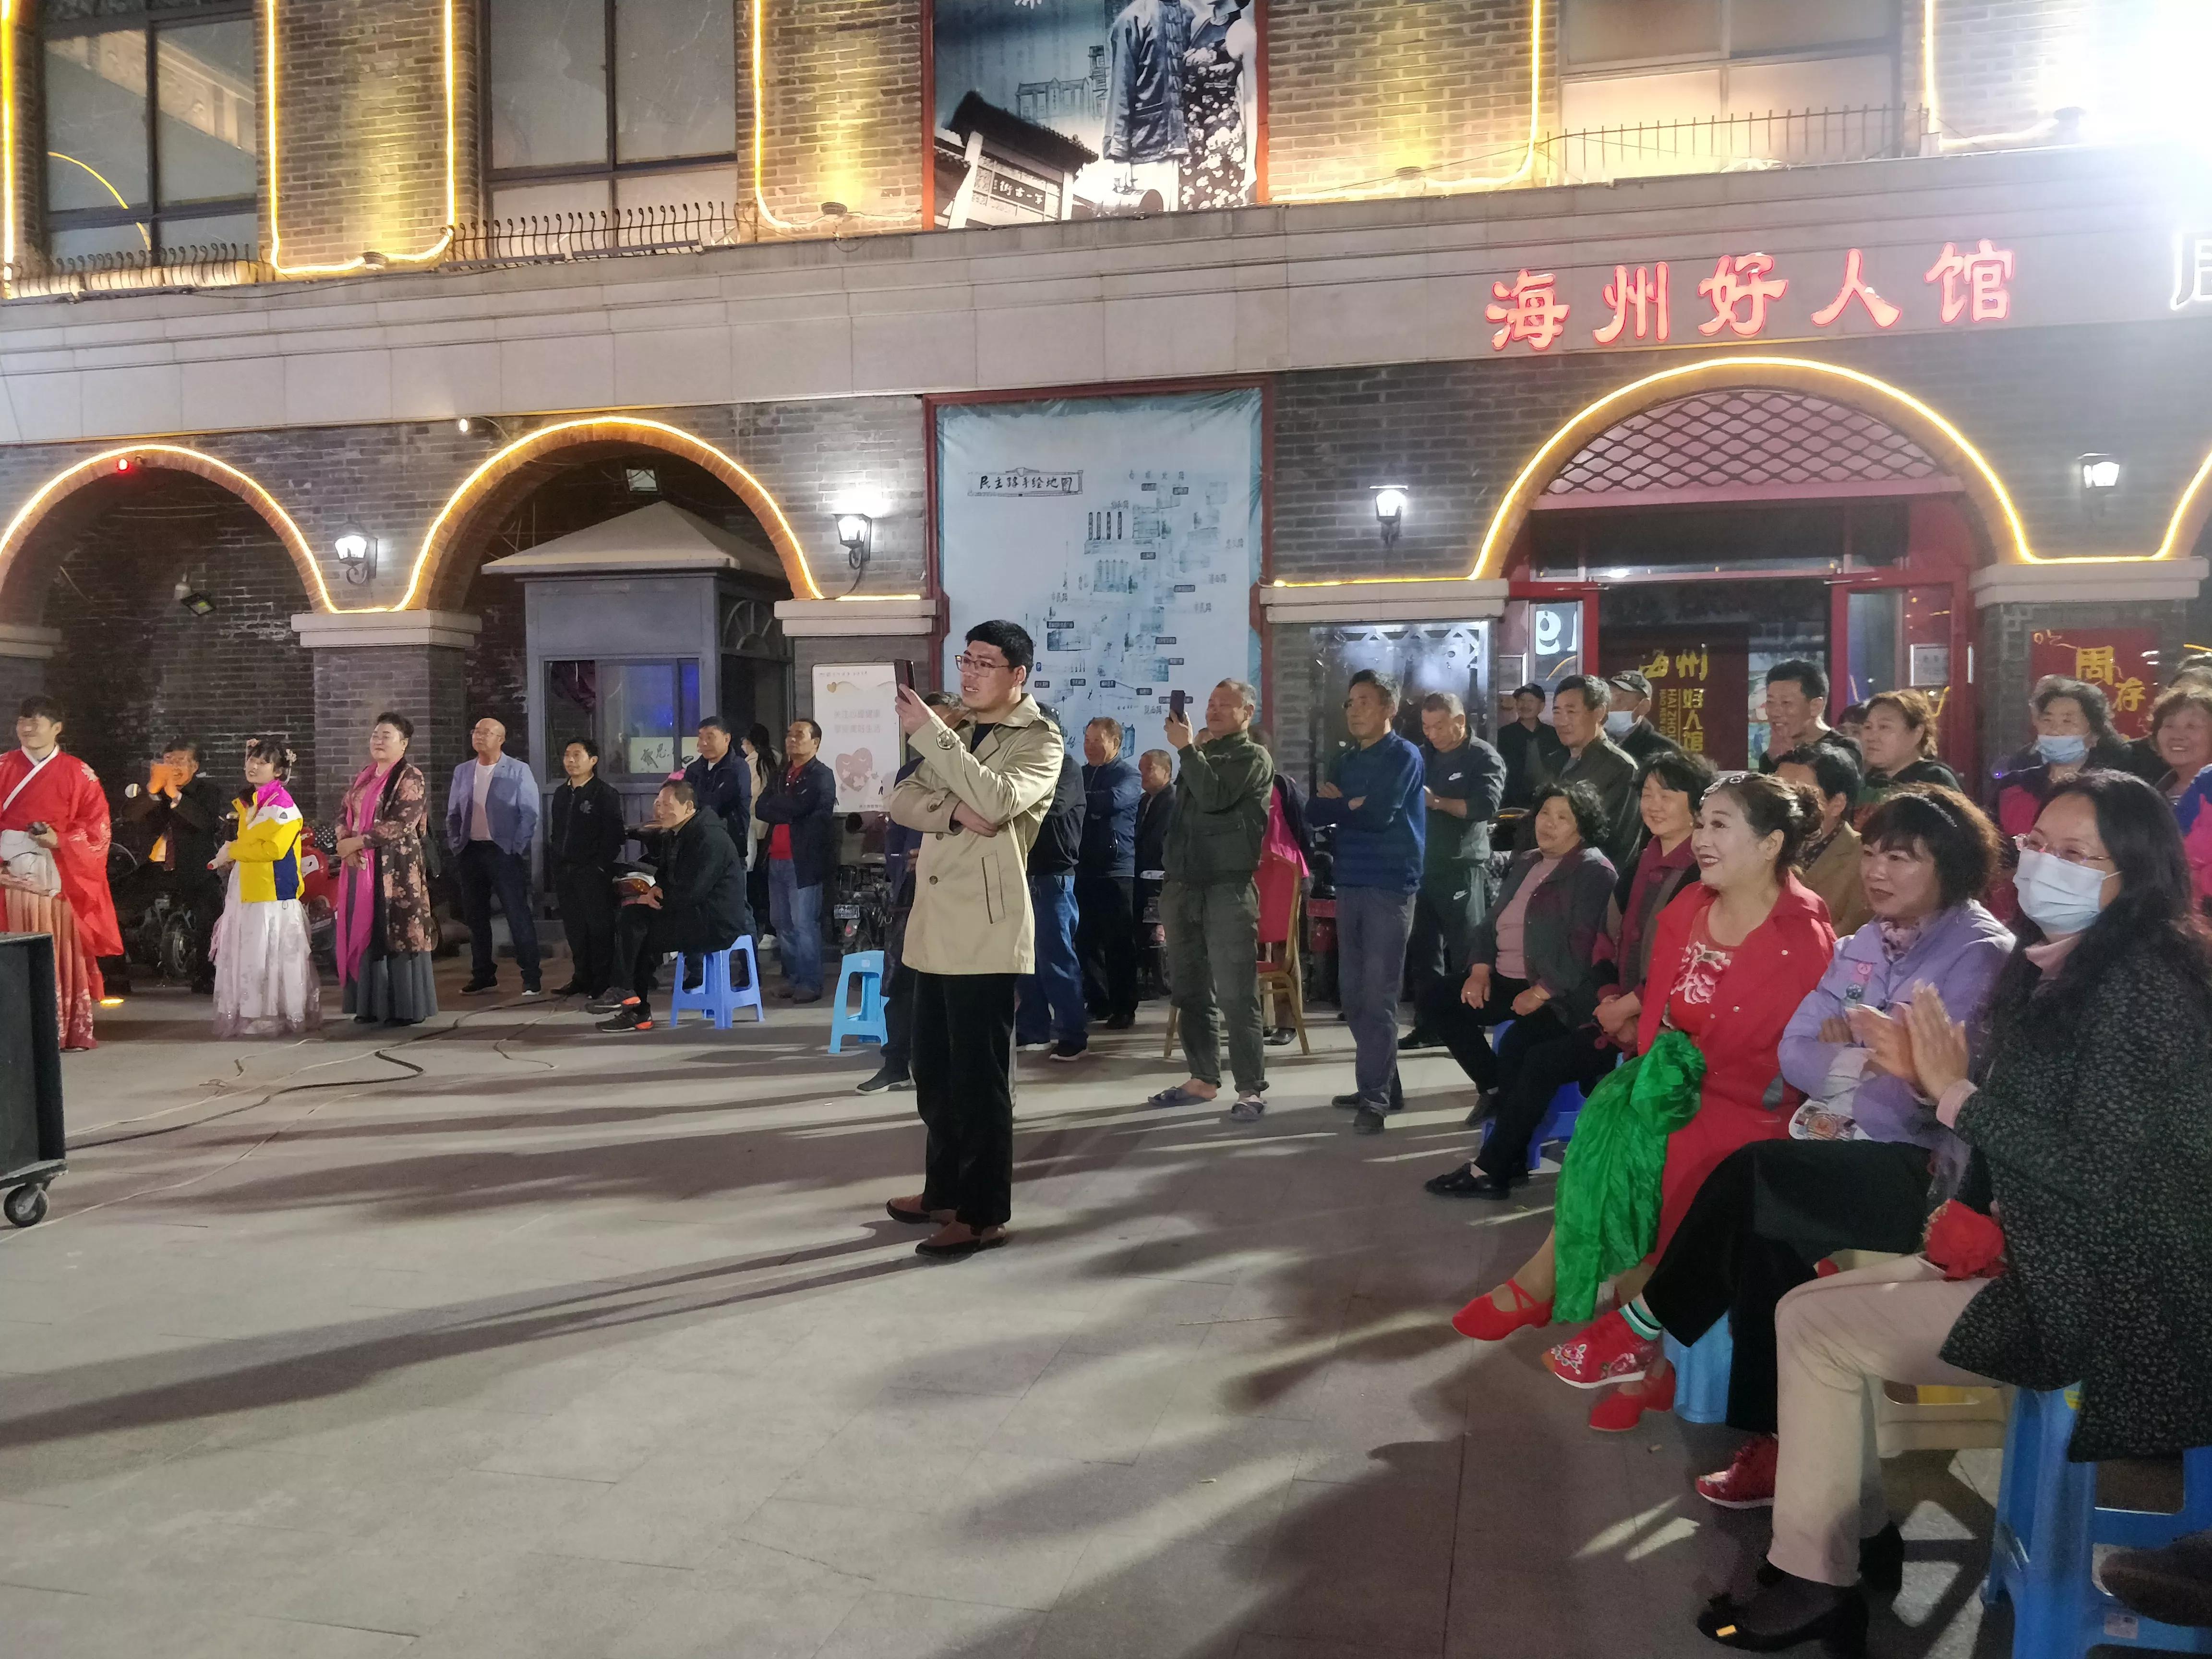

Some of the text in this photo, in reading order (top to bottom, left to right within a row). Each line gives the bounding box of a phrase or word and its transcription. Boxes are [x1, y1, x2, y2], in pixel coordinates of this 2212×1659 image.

[1484, 238, 2015, 350] 海州好人馆
[1667, 688, 1677, 708] HAI
[1683, 688, 1704, 751] 好人馆
